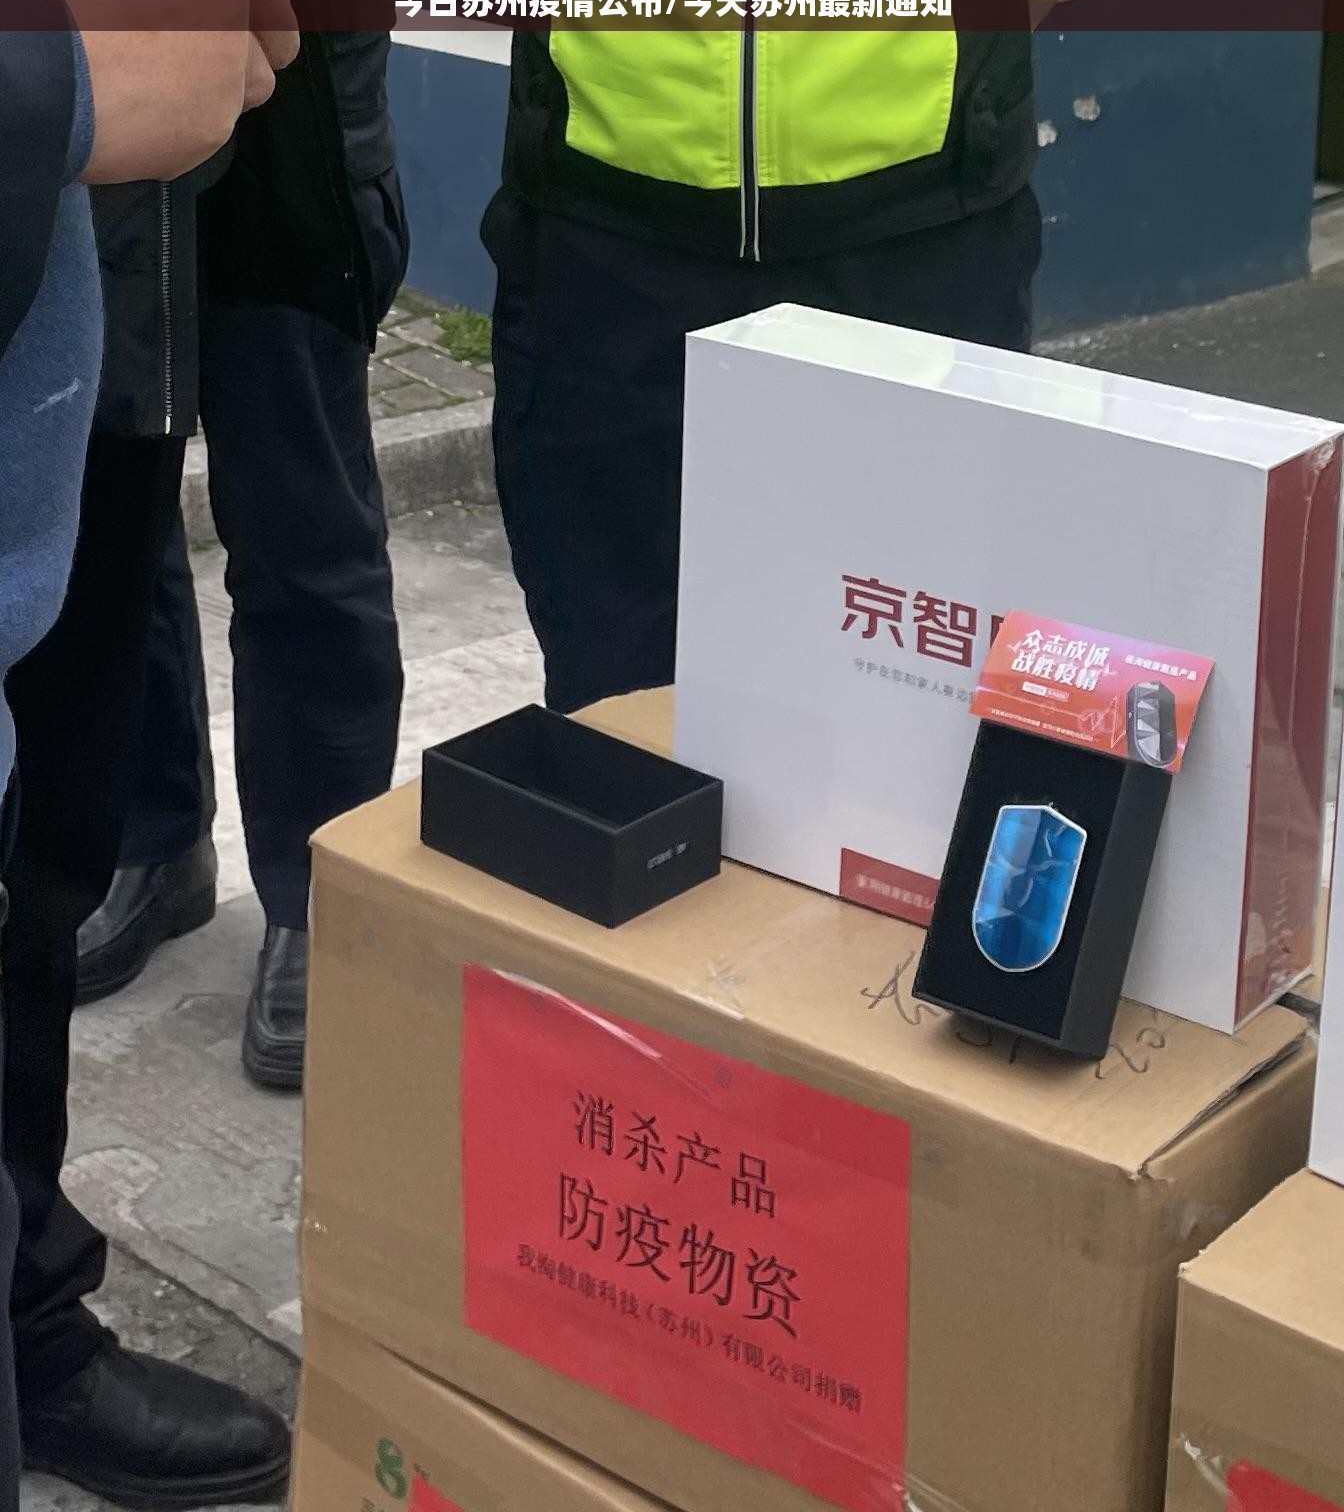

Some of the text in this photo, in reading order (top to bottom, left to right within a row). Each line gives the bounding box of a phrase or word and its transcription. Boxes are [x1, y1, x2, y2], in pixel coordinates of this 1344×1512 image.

[840, 573, 1005, 668] 京智
[1010, 651, 1104, 692] 战胜疫情
[572, 1088, 776, 1220] 消杀产品
[558, 1170, 802, 1339] 防疫物资
